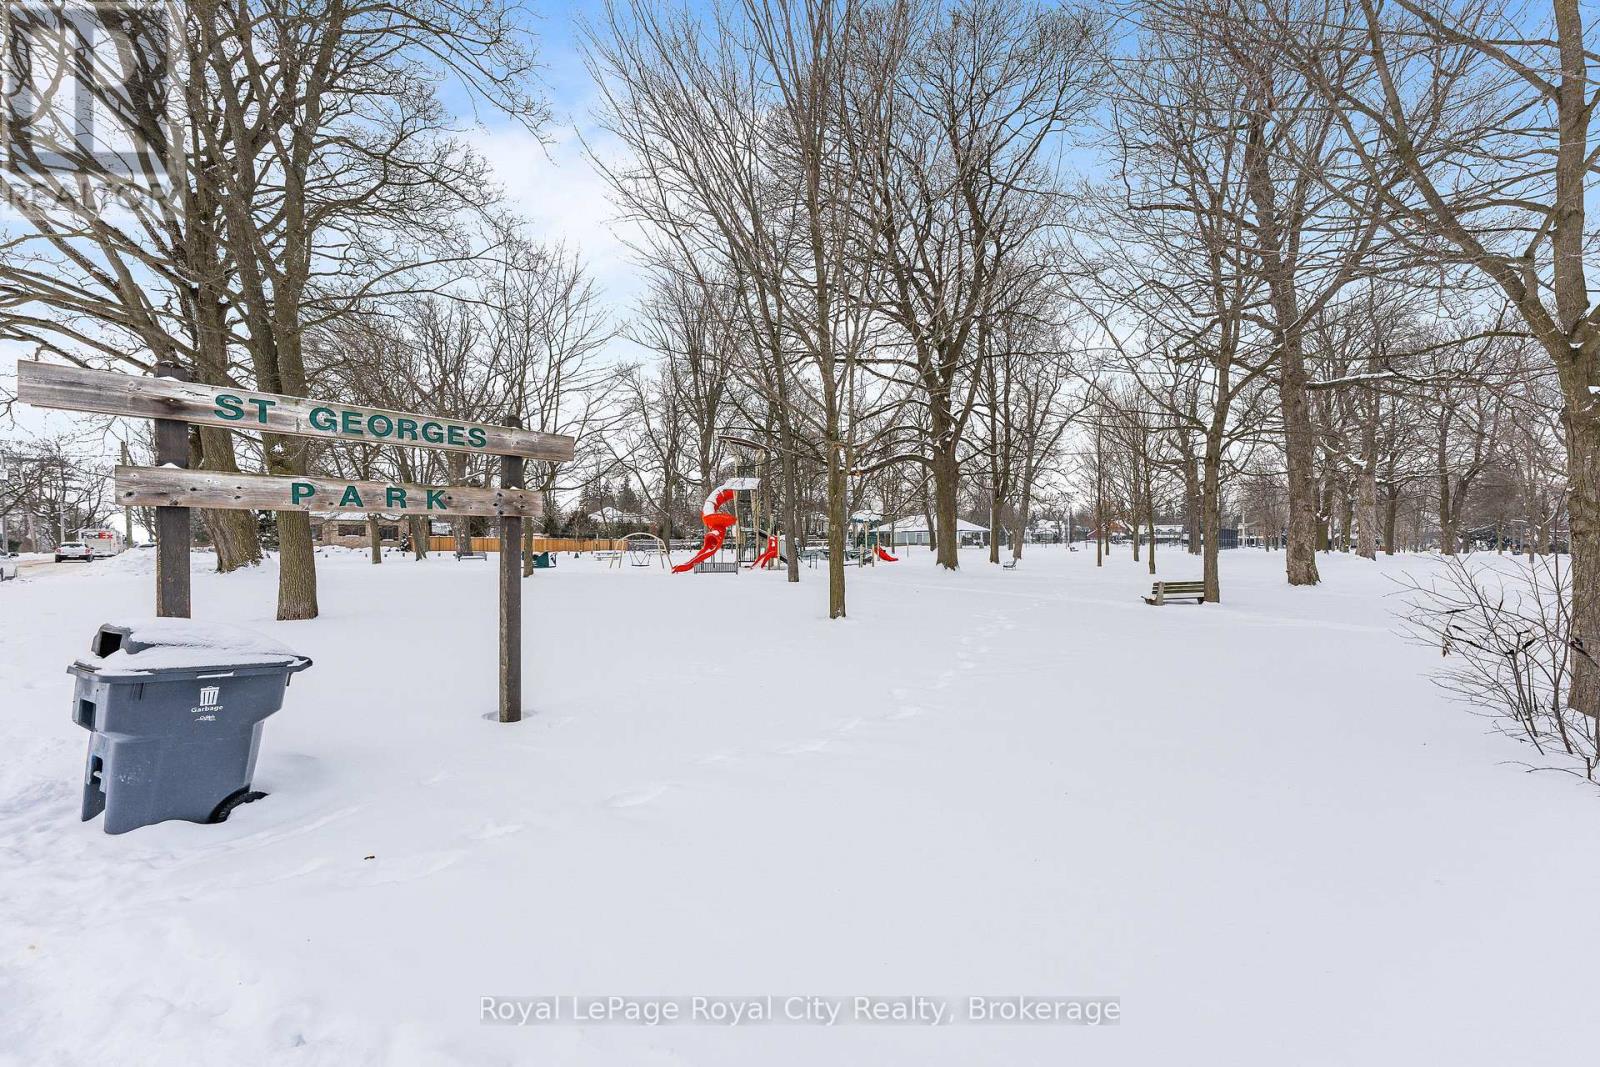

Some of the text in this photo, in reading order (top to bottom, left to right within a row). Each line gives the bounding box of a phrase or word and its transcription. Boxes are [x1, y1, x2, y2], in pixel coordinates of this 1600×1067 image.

[214, 394, 487, 448] ST GEORGES
[291, 482, 447, 510] PARK
